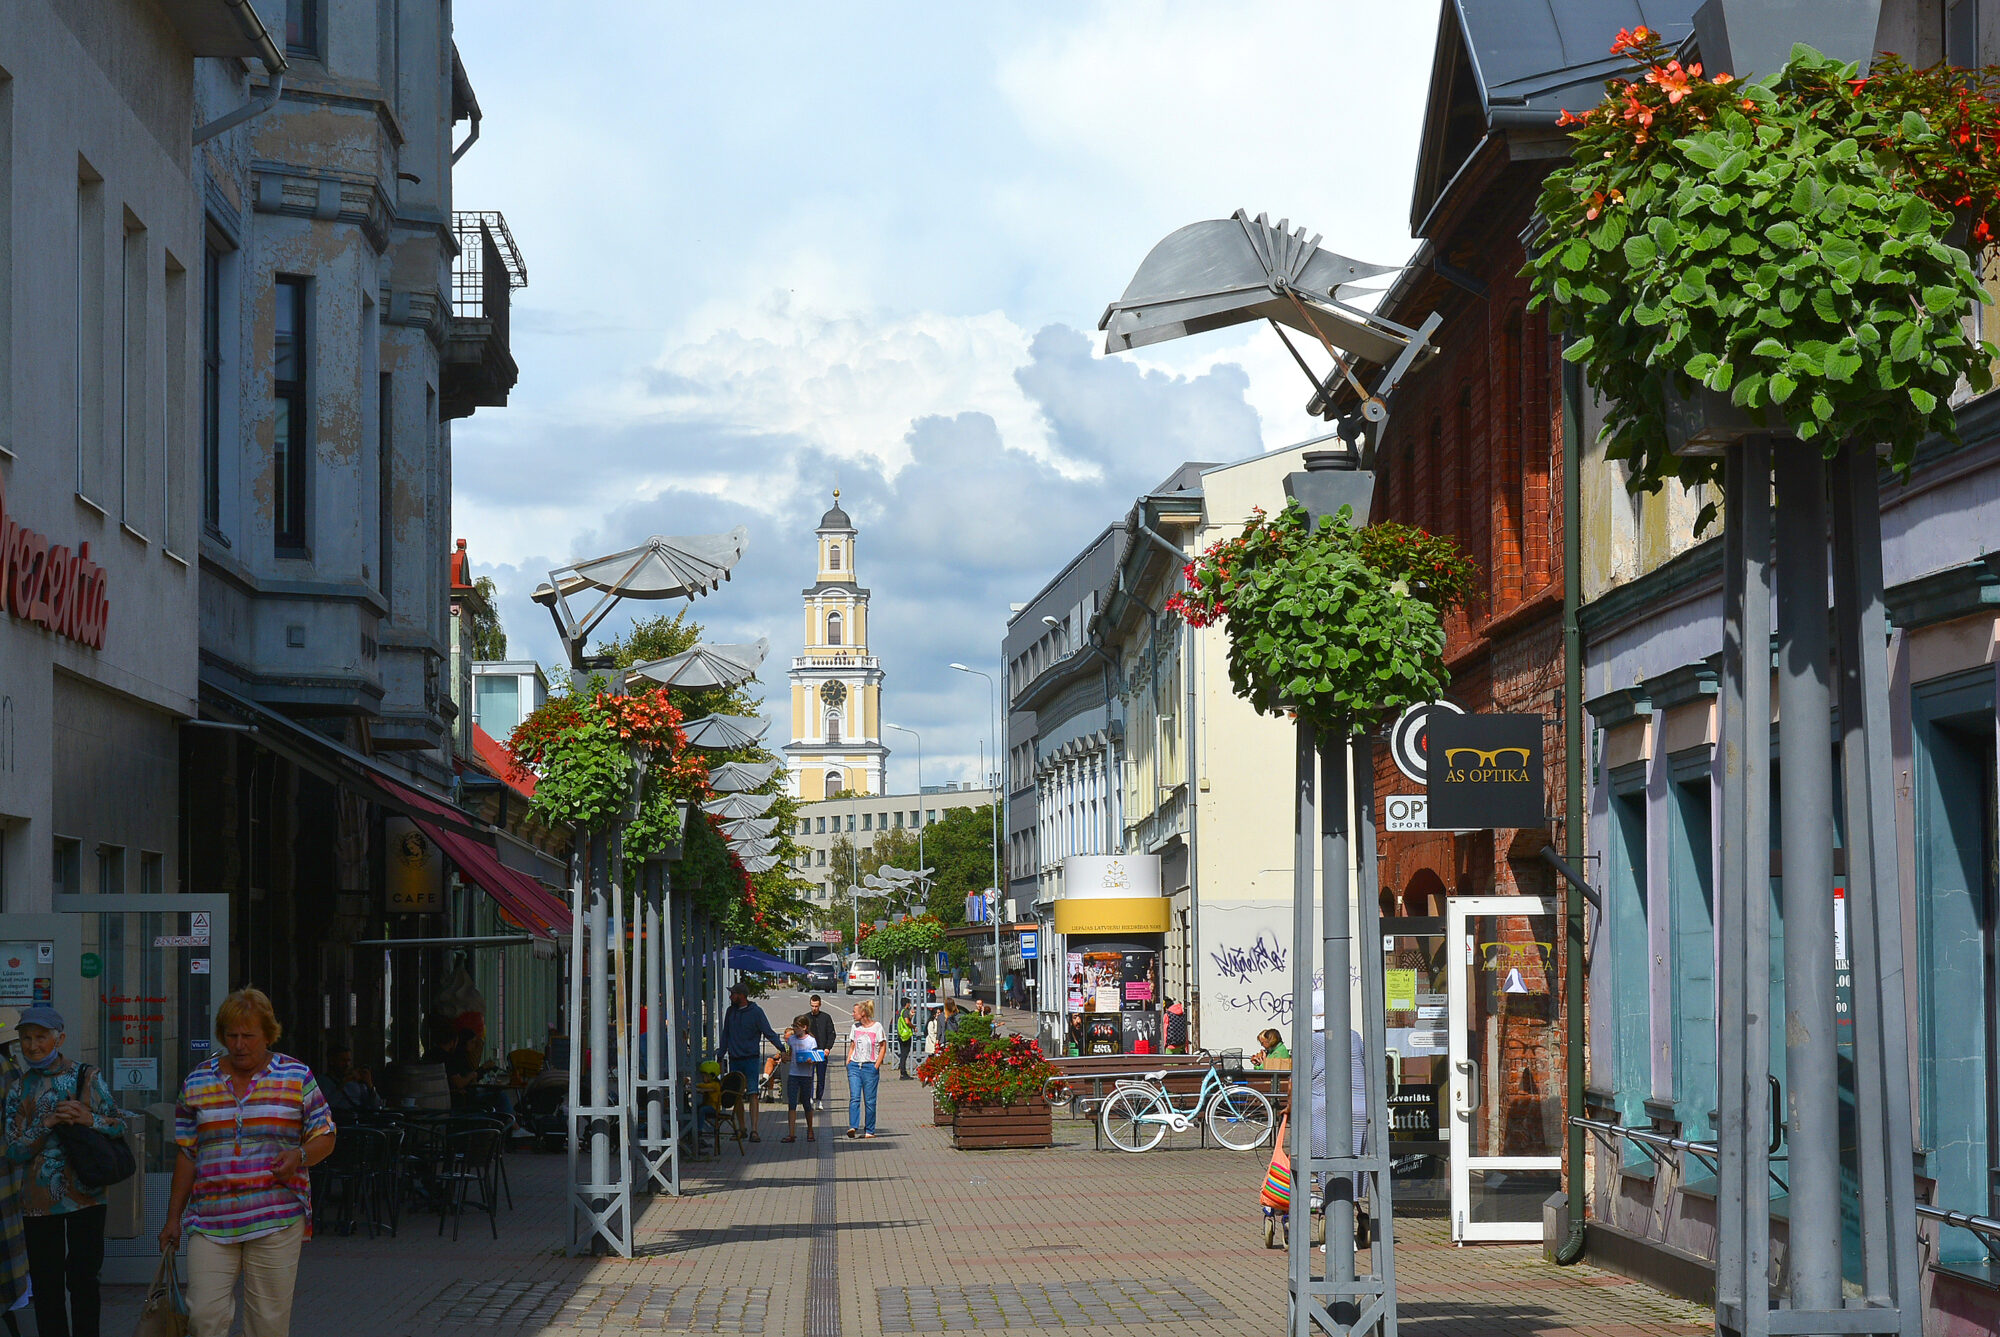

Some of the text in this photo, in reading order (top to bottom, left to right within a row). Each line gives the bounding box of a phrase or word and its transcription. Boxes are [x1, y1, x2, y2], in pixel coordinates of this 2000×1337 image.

[1445, 769, 1530, 782] AS OPTIKA
[1389, 800, 1428, 820] OP
[392, 893, 436, 903] CAFE
[110, 1014, 139, 1022] DARBA
[121, 1036, 134, 1045] 10
[1387, 1093, 1431, 1102] ikvariāts
